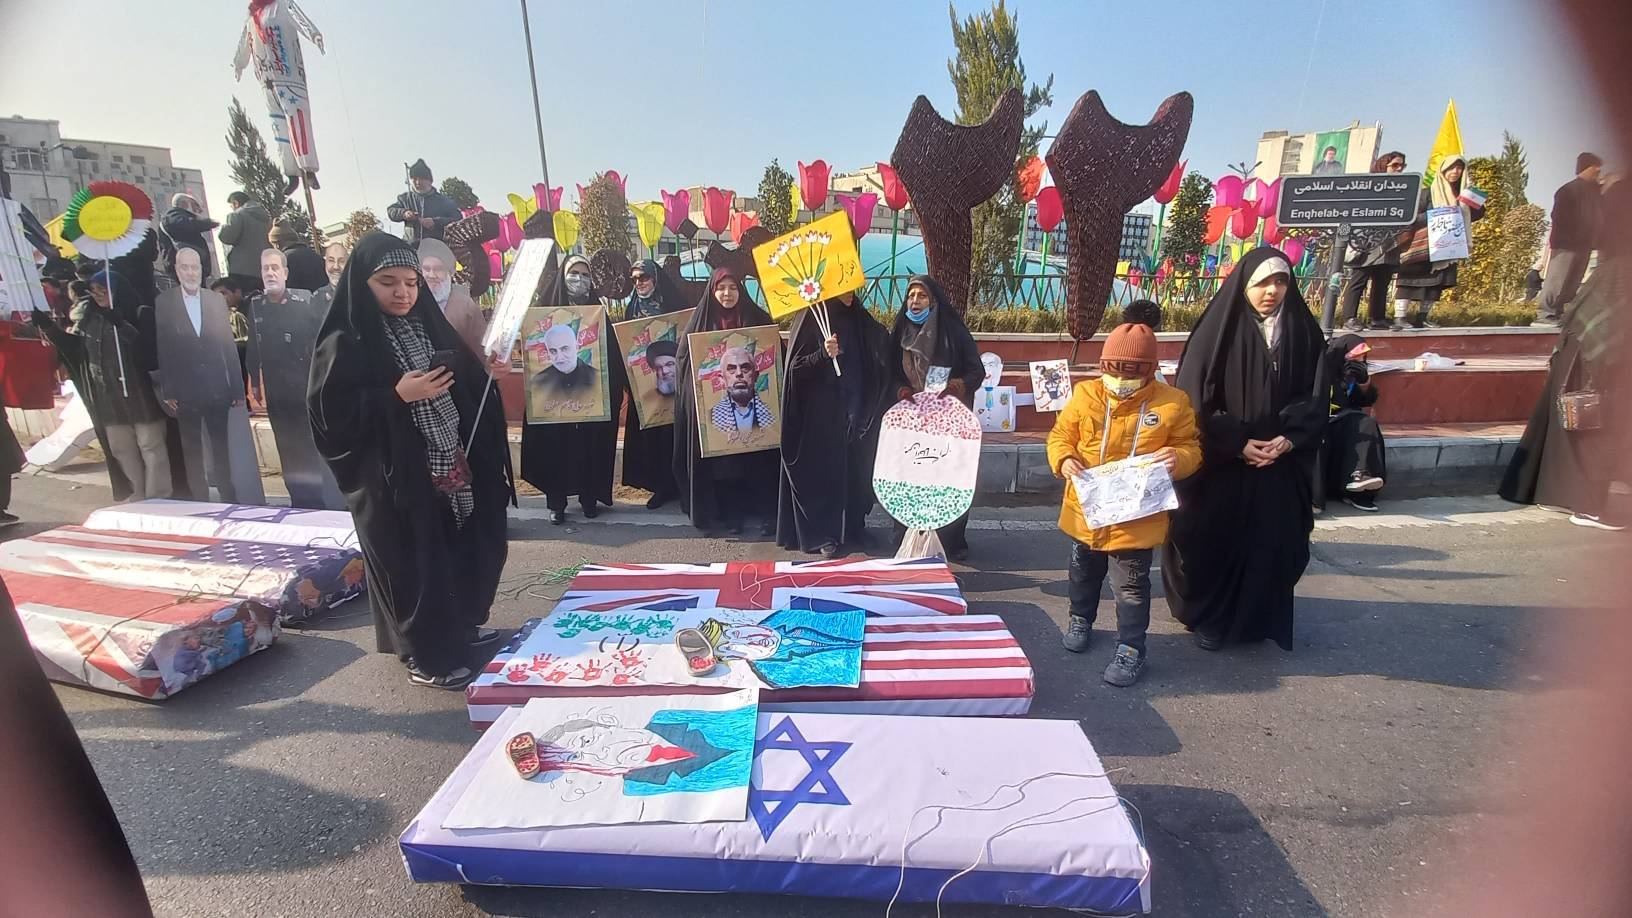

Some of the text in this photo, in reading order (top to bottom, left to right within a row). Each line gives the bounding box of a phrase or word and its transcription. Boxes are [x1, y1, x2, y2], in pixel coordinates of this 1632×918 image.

[1294, 180, 1408, 195] میدان انقلاب اسلامی
[1351, 207, 1388, 217] Eslami
[1389, 206, 1405, 218] Sq
